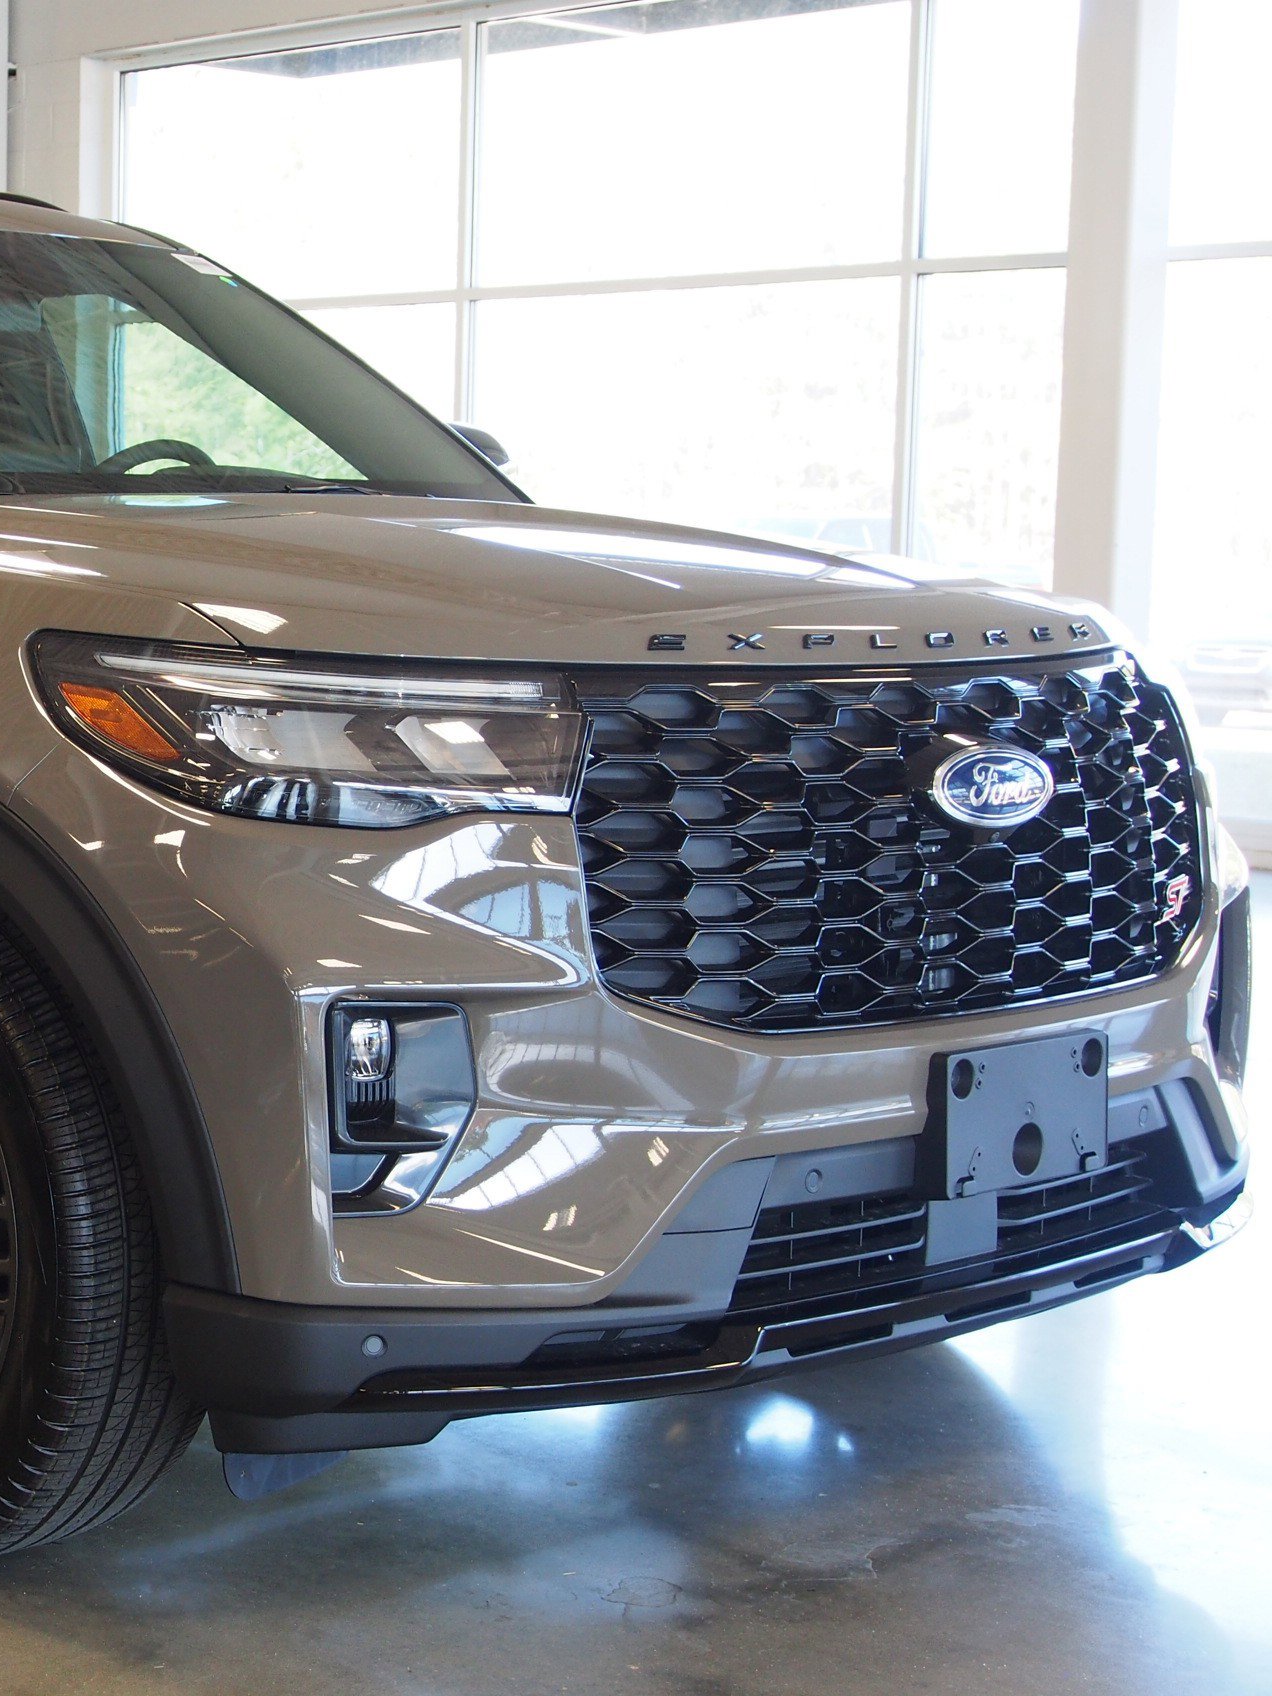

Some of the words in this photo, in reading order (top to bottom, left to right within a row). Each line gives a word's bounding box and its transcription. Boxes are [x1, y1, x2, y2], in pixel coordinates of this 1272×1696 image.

[647, 622, 1092, 650] EXPLORER
[970, 762, 1044, 807] Ford
[1163, 874, 1190, 920] ST
